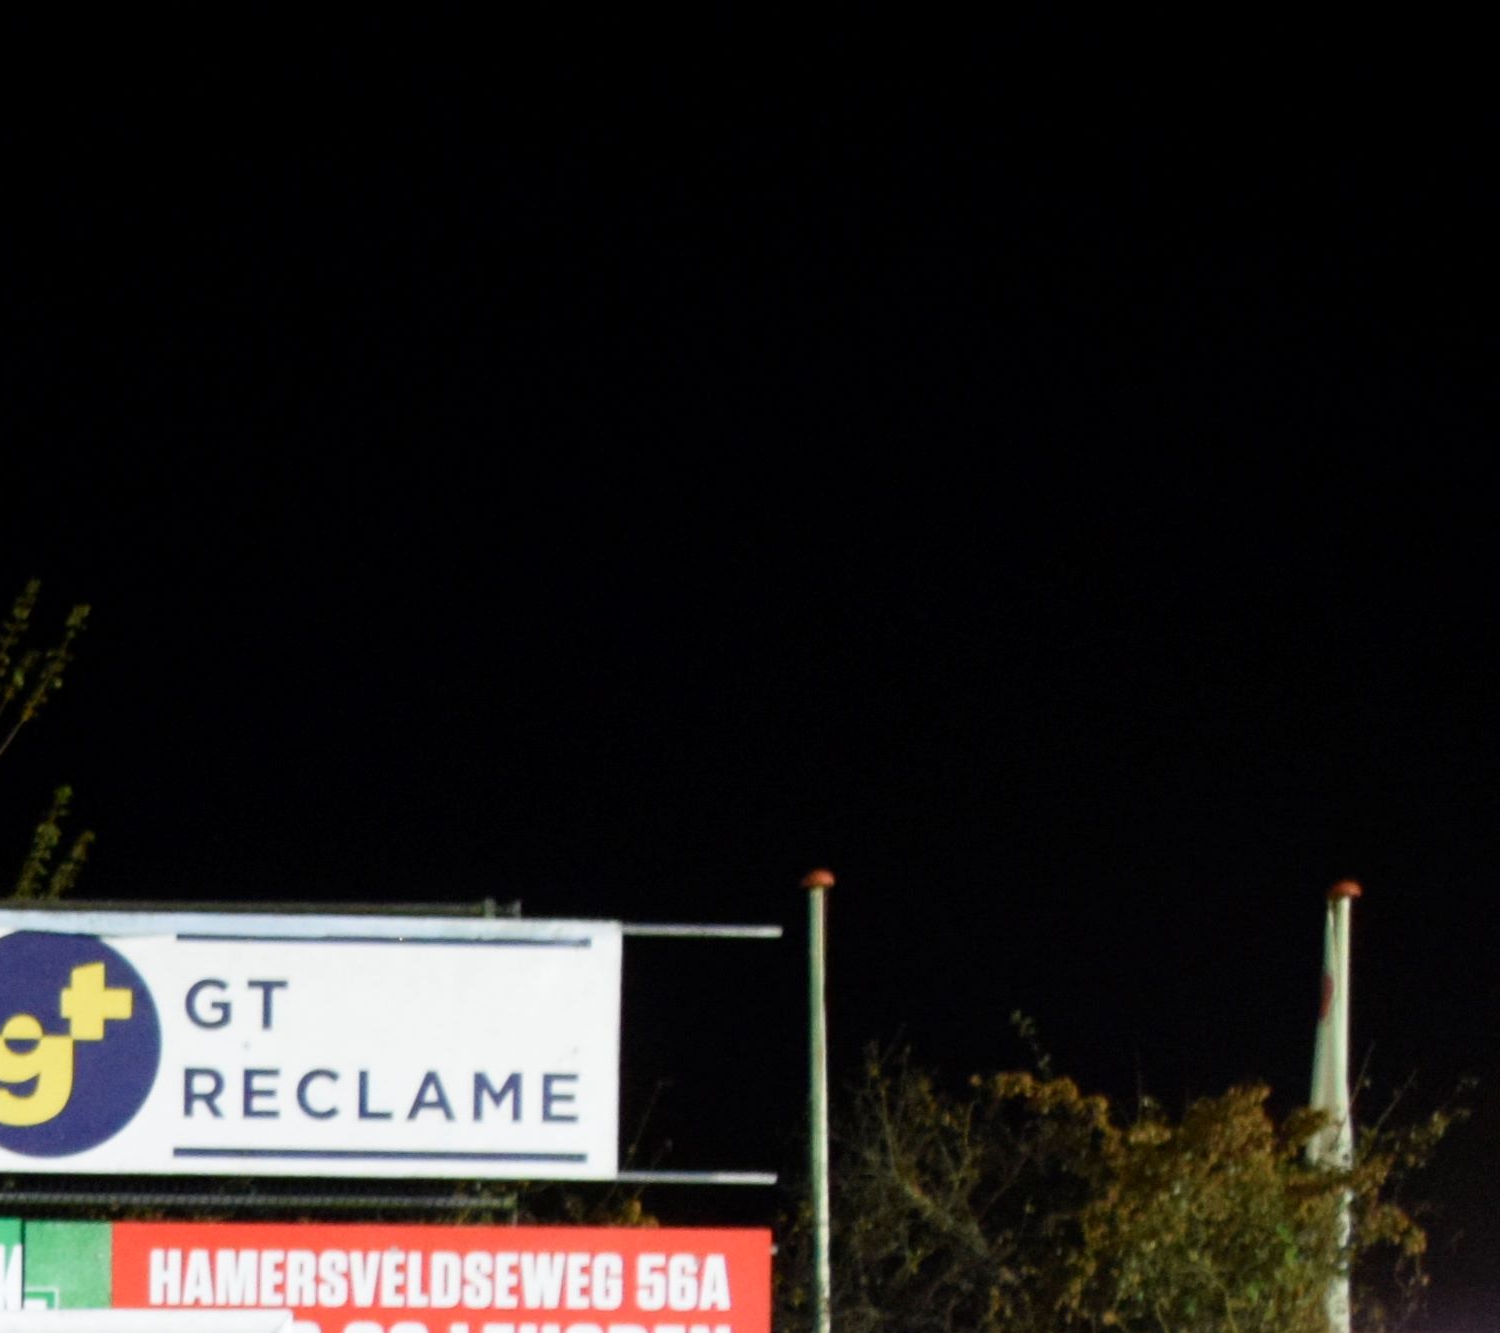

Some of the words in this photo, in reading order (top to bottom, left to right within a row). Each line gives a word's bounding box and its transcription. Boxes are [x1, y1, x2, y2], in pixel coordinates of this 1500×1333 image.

[187, 980, 286, 1027] GT
[185, 1069, 574, 1120] RECLAME
[148, 1248, 623, 1309] HAMERSVELDSEWEG
[635, 1252, 732, 1312] 56A
